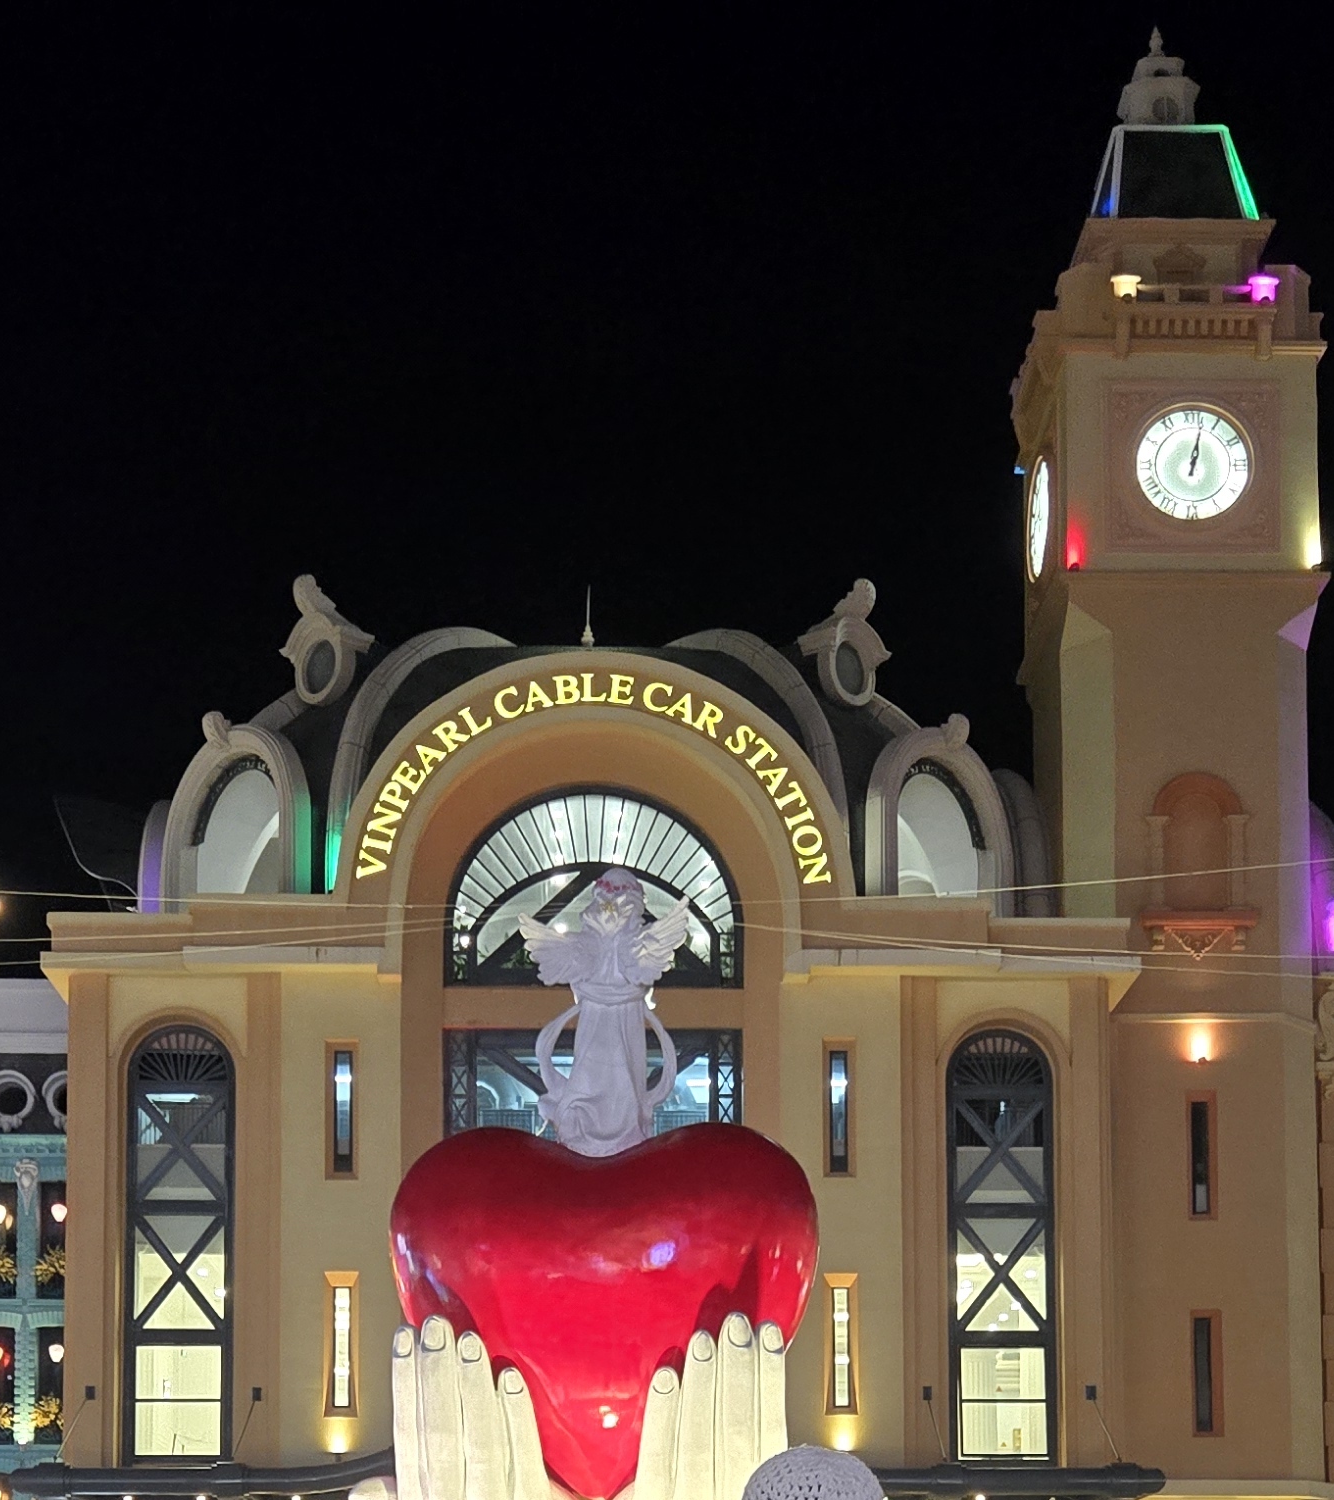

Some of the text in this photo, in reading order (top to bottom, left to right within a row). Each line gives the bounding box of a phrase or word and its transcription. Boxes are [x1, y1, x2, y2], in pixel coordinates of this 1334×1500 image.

[355, 673, 832, 886] VINPEARL CABLE CAR STATION
